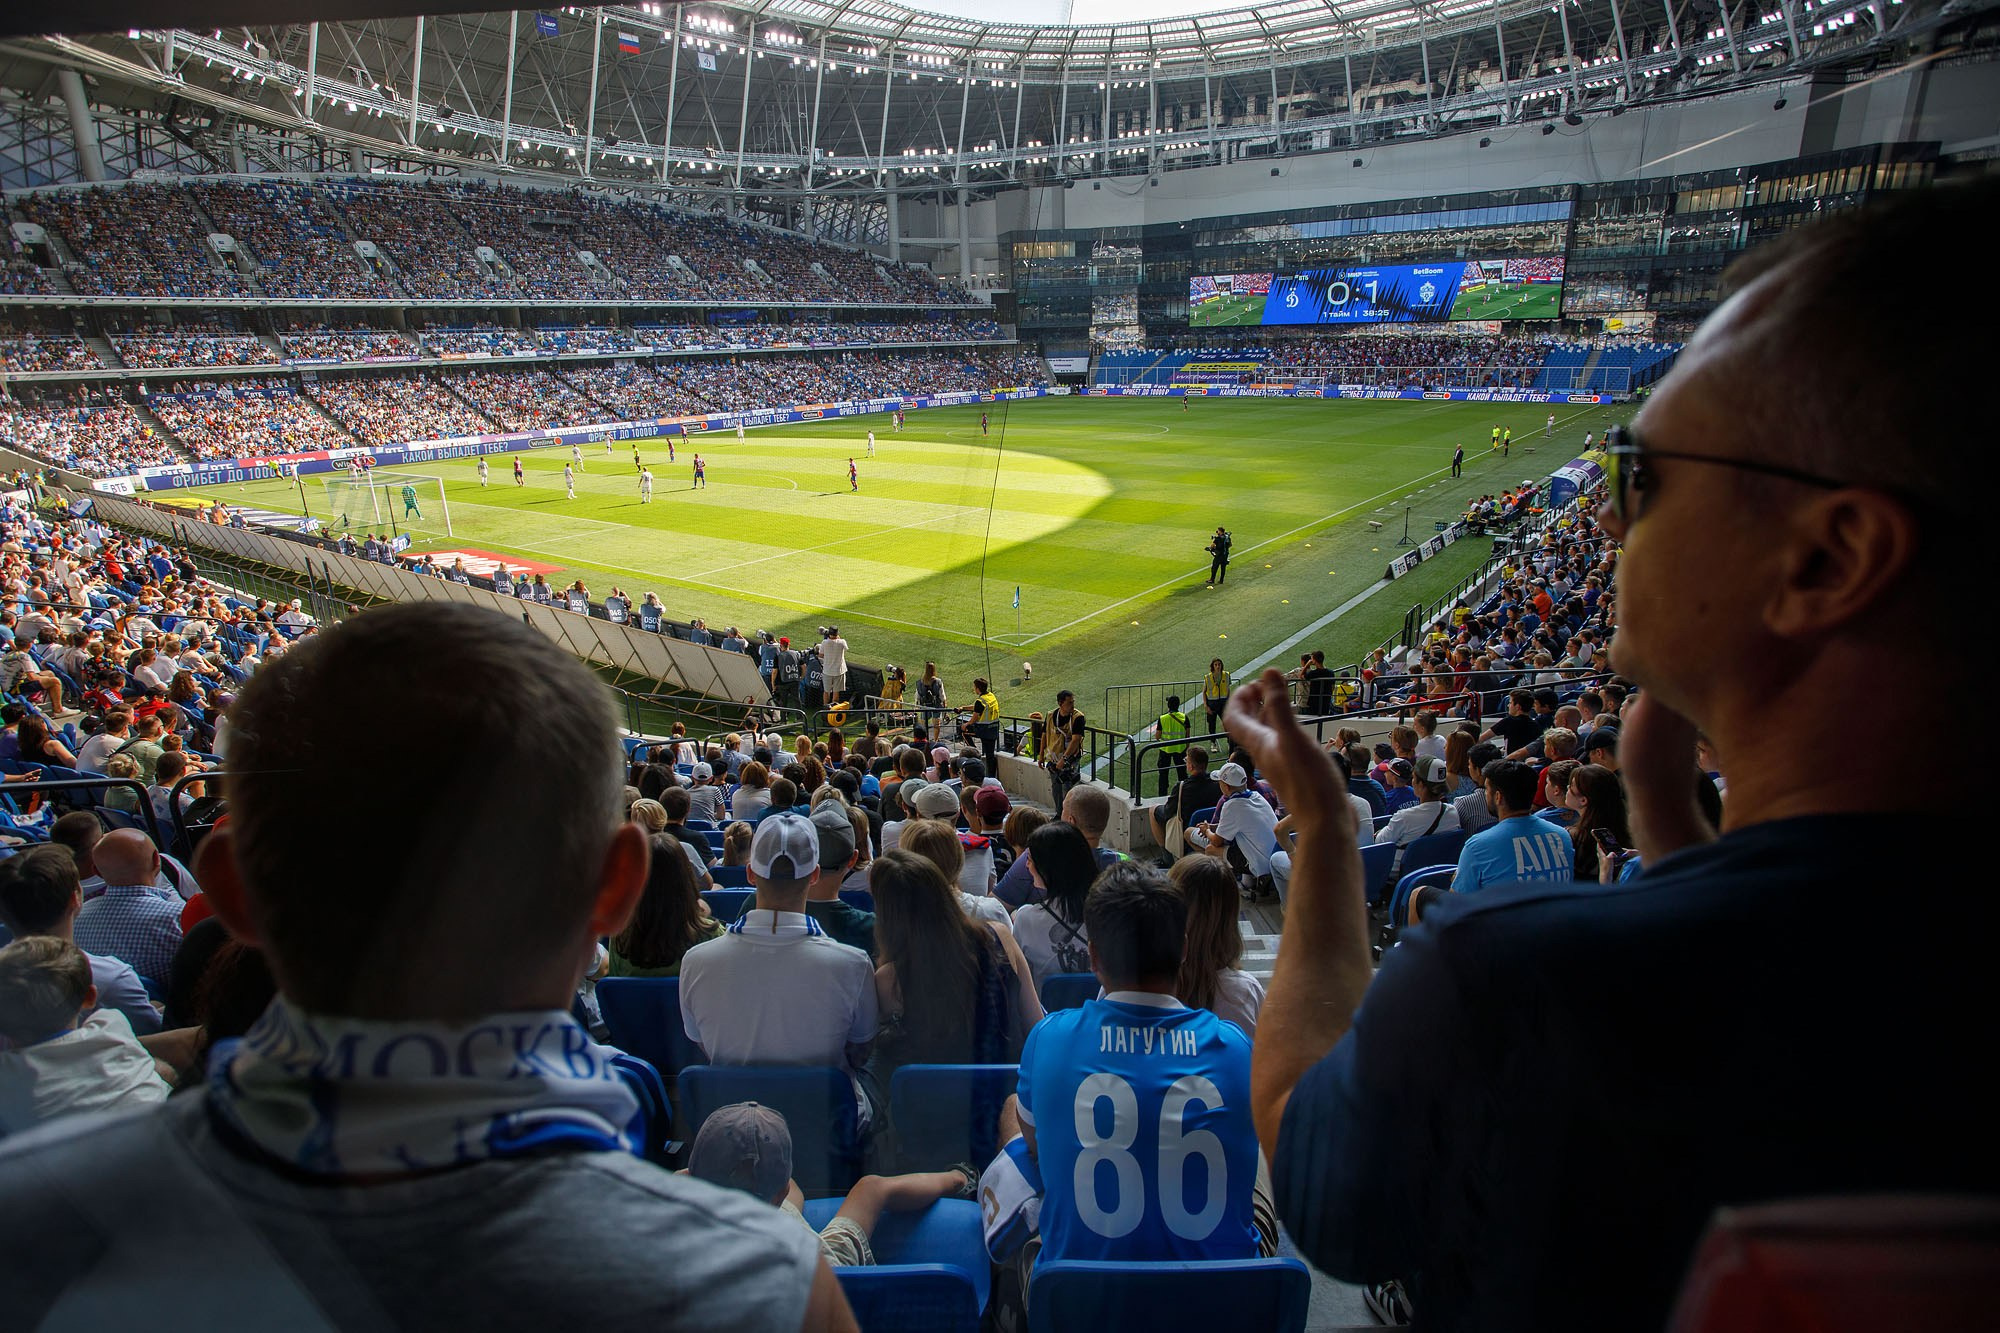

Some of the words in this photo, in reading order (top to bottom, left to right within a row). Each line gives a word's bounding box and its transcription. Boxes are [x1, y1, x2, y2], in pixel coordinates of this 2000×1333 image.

[1362, 309, 1390, 317] 38:25
[1528, 394, 1550, 402] ТЕБЕ?
[619, 429, 630, 440] ДО
[438, 445, 480, 459] ВЫПАДЕТ
[483, 441, 509, 454] ТЕБЕ?
[172, 471, 222, 488] ФРИБЕТ
[227, 467, 244, 483] ДО
[110, 482, 128, 494] ВТБ
[571, 599, 583, 607] 055
[609, 609, 622, 617] 048
[644, 616, 657, 624] 050
[1512, 832, 1569, 874] AIR
[1100, 1025, 1197, 1057] ЛАГУТИН
[303, 1024, 616, 1080] МОСКВ
[1073, 1072, 1228, 1241] 86
